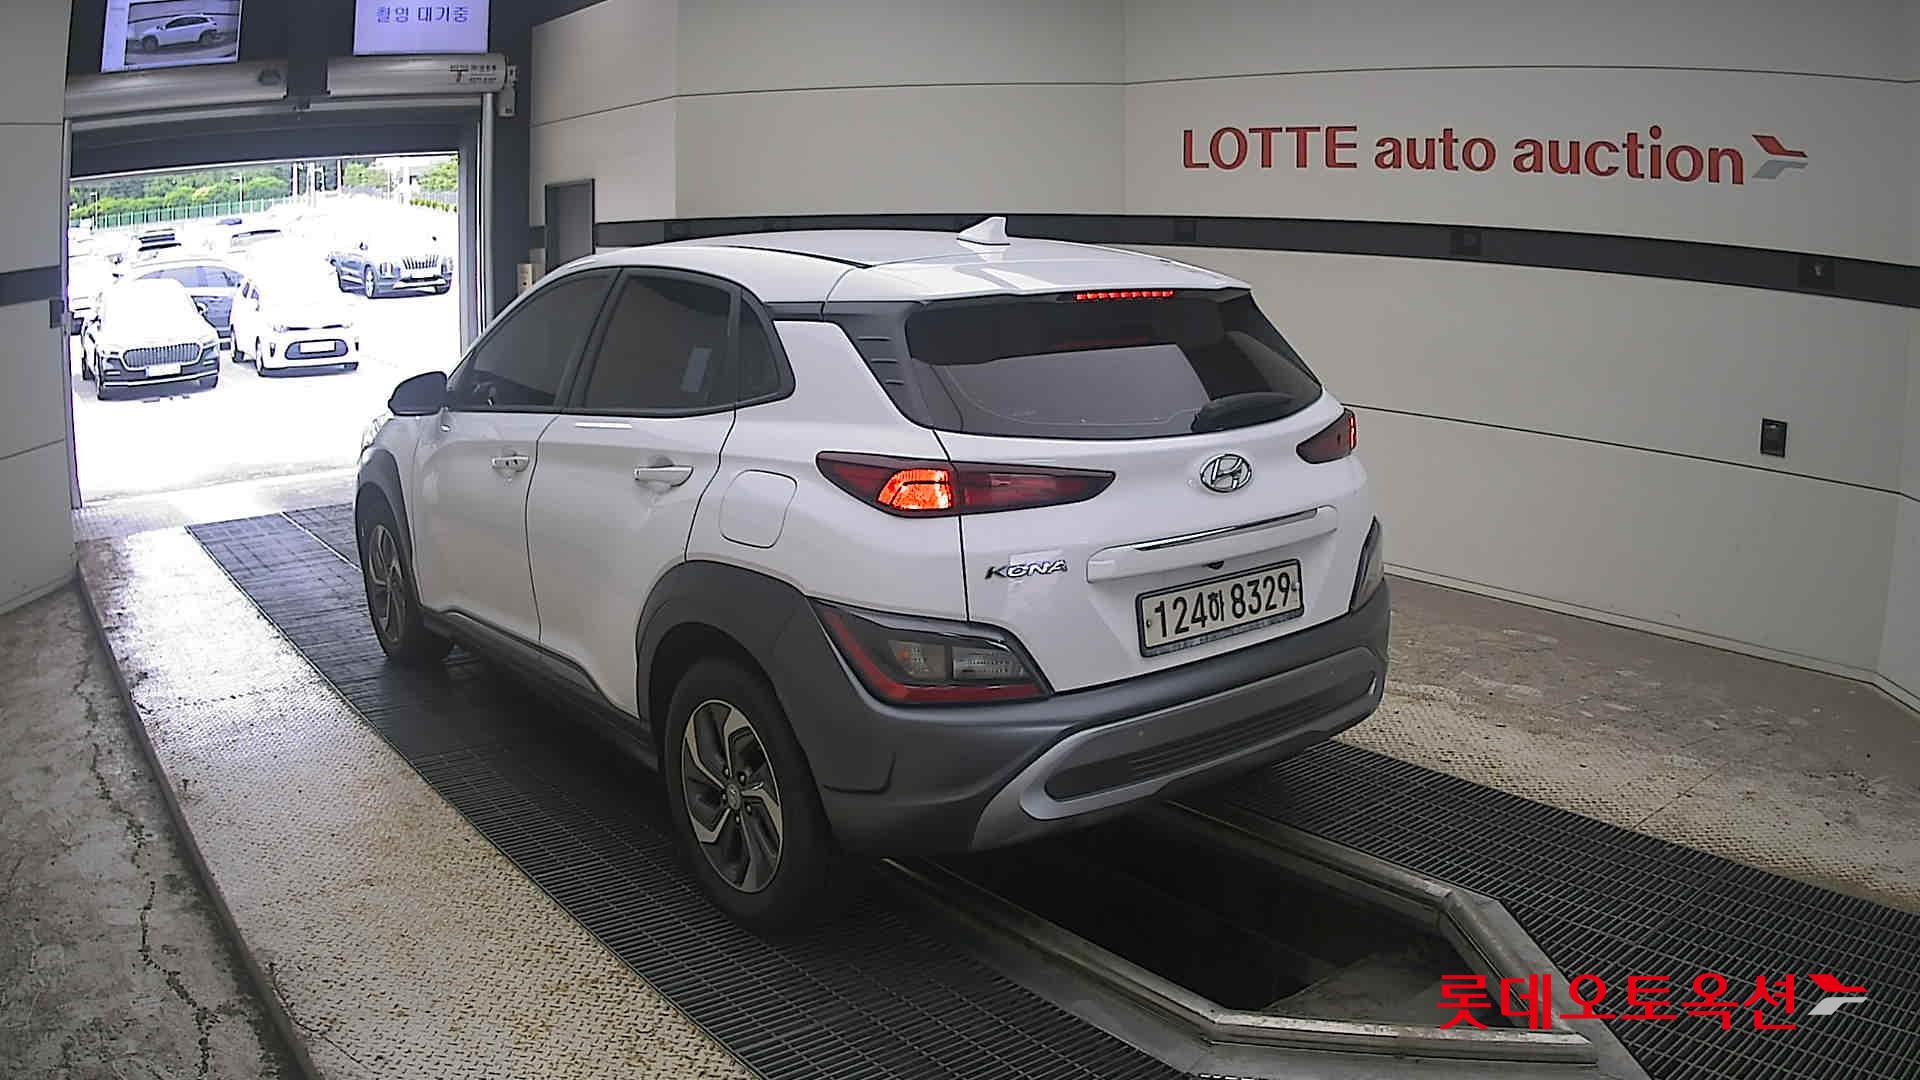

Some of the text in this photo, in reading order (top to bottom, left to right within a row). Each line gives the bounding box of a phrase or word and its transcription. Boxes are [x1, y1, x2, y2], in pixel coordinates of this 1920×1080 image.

[417, 6, 469, 23] 대기중
[1183, 125, 1744, 184] LOTTE auto auction
[985, 559, 1067, 579] KONA
